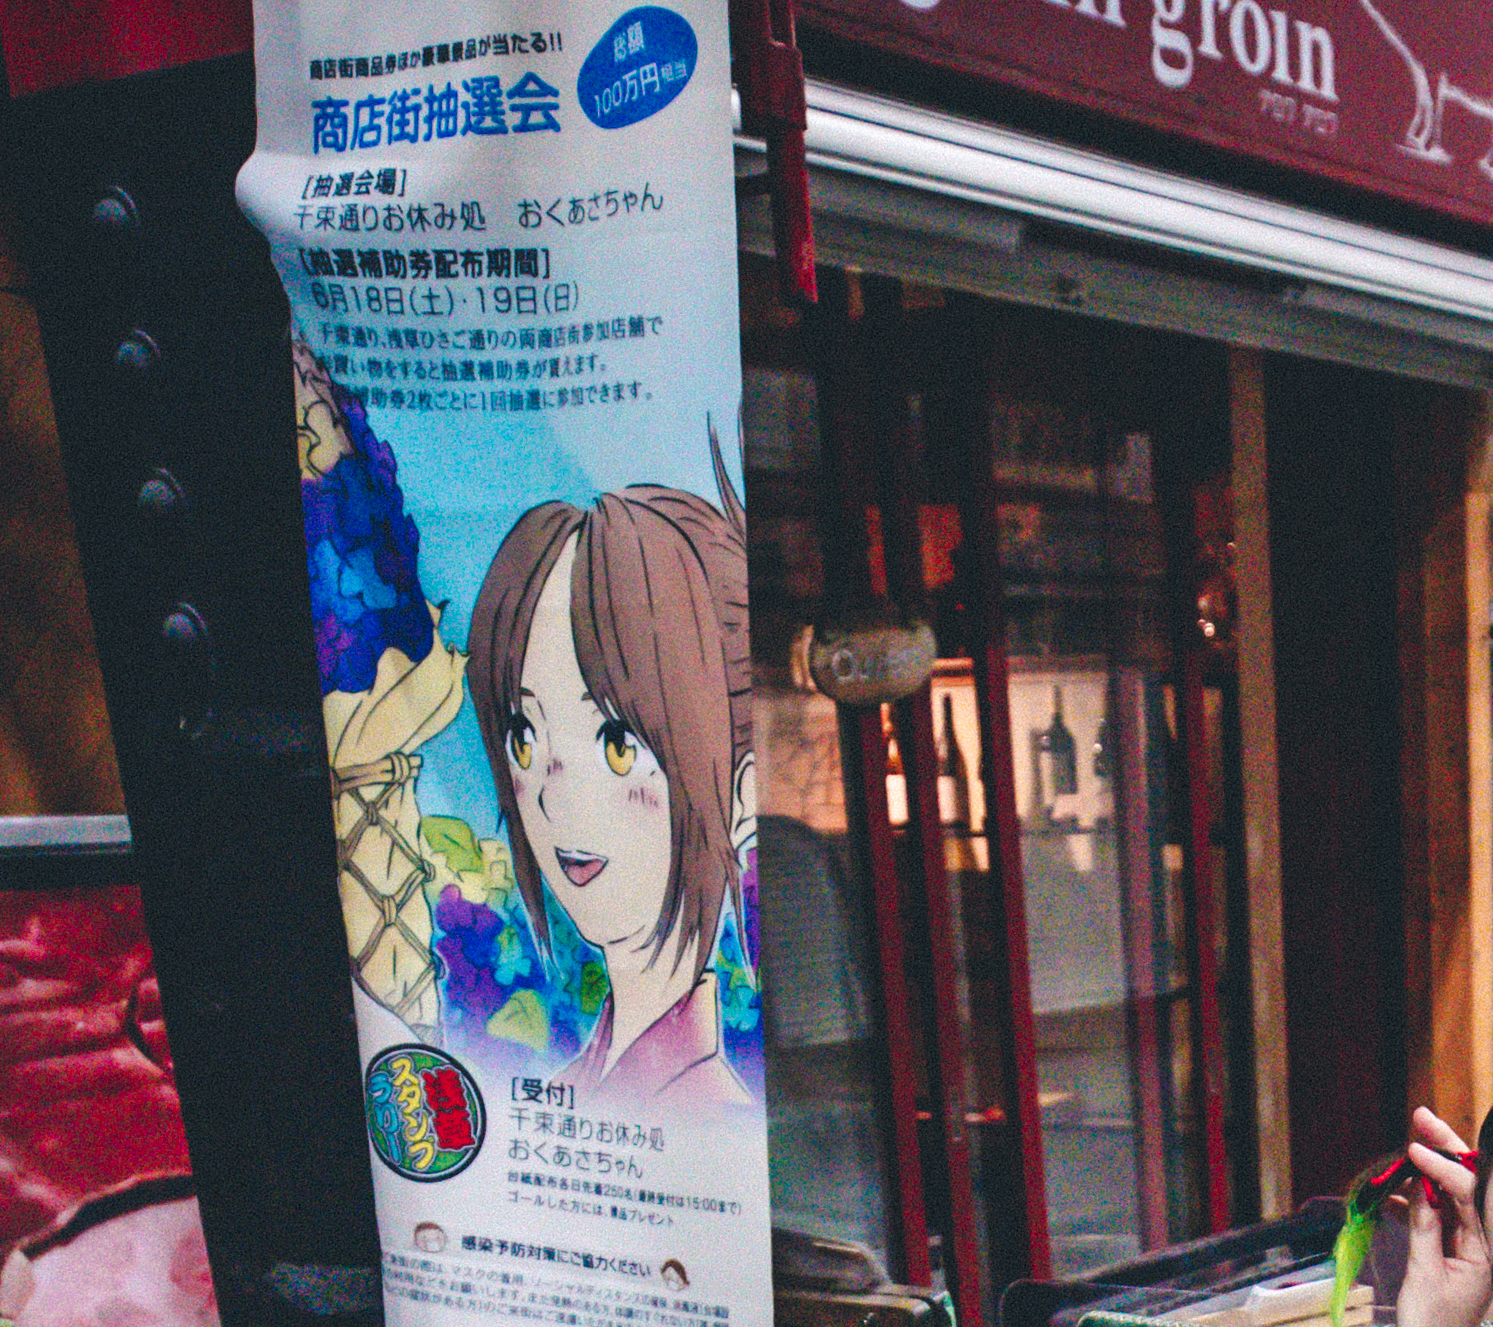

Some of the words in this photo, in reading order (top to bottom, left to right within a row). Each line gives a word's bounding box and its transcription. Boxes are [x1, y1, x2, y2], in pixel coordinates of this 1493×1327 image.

[1151, 0, 1340, 102] groin
[310, 72, 562, 156] 商店街抽選会
[516, 181, 665, 230] おくあさちゃん
[510, 1076, 575, 1110] [受付]
[507, 1138, 644, 1180] おくあさちゃん
